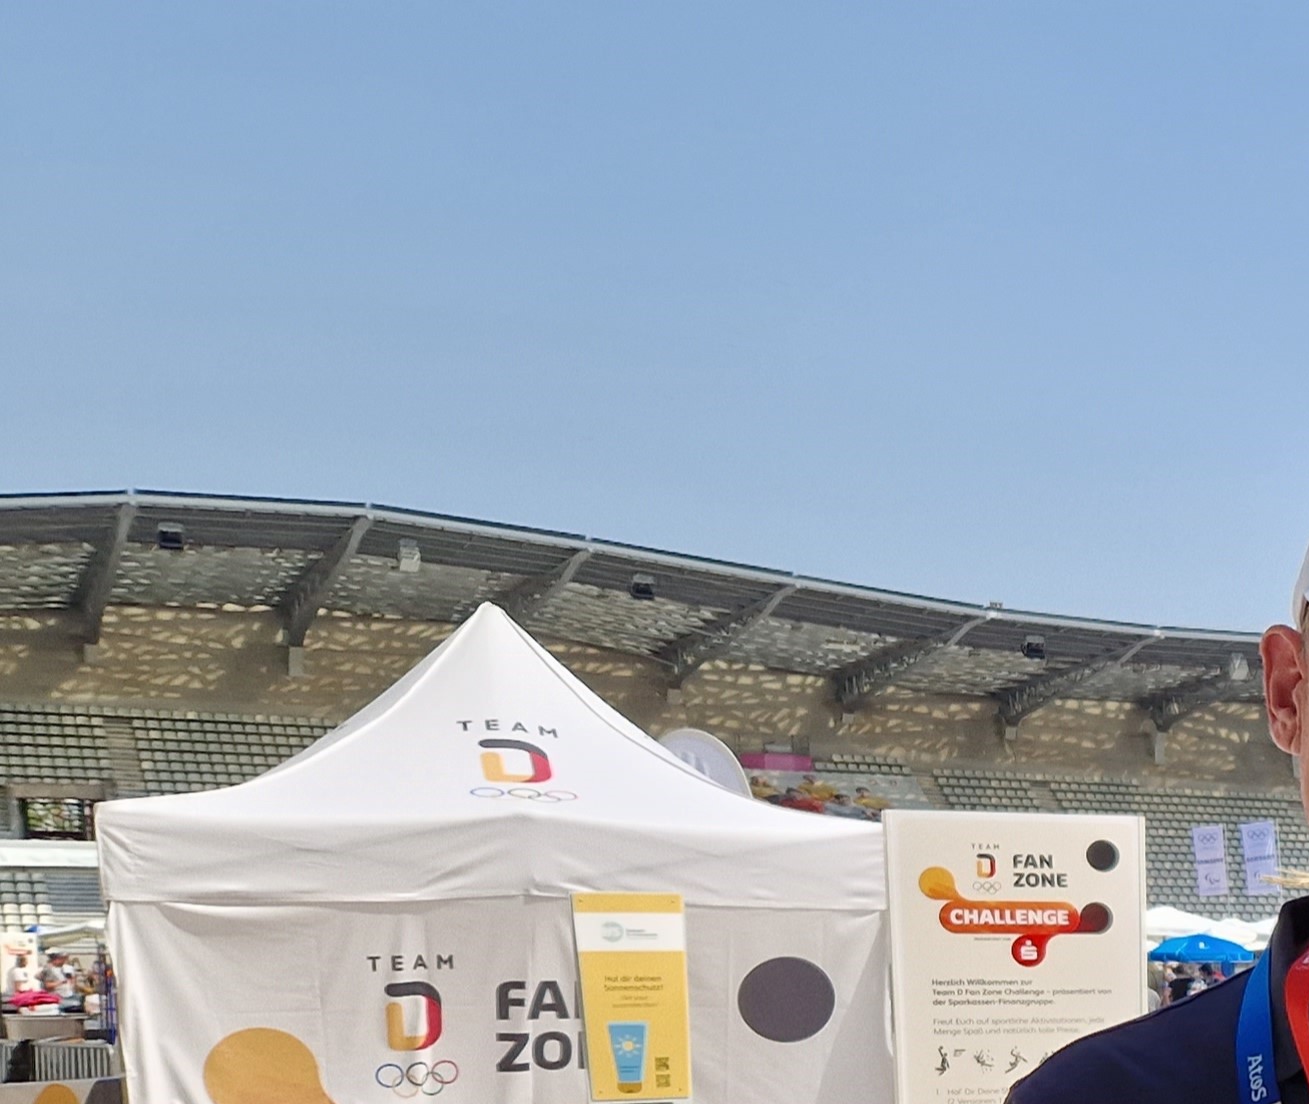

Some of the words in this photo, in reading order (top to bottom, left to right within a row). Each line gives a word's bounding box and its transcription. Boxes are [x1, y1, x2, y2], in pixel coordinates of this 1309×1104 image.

[456, 719, 559, 739] TEAM
[1012, 854, 1054, 870] FAN
[1012, 873, 1069, 888] ZONE
[949, 909, 1070, 926] CHALLENGE
[366, 954, 455, 973] TEAM
[495, 980, 583, 1020] FA
[1004, 988, 1044, 997] Challenge
[495, 1031, 587, 1073] ZO
[1247, 1054, 1267, 1102] Atos
